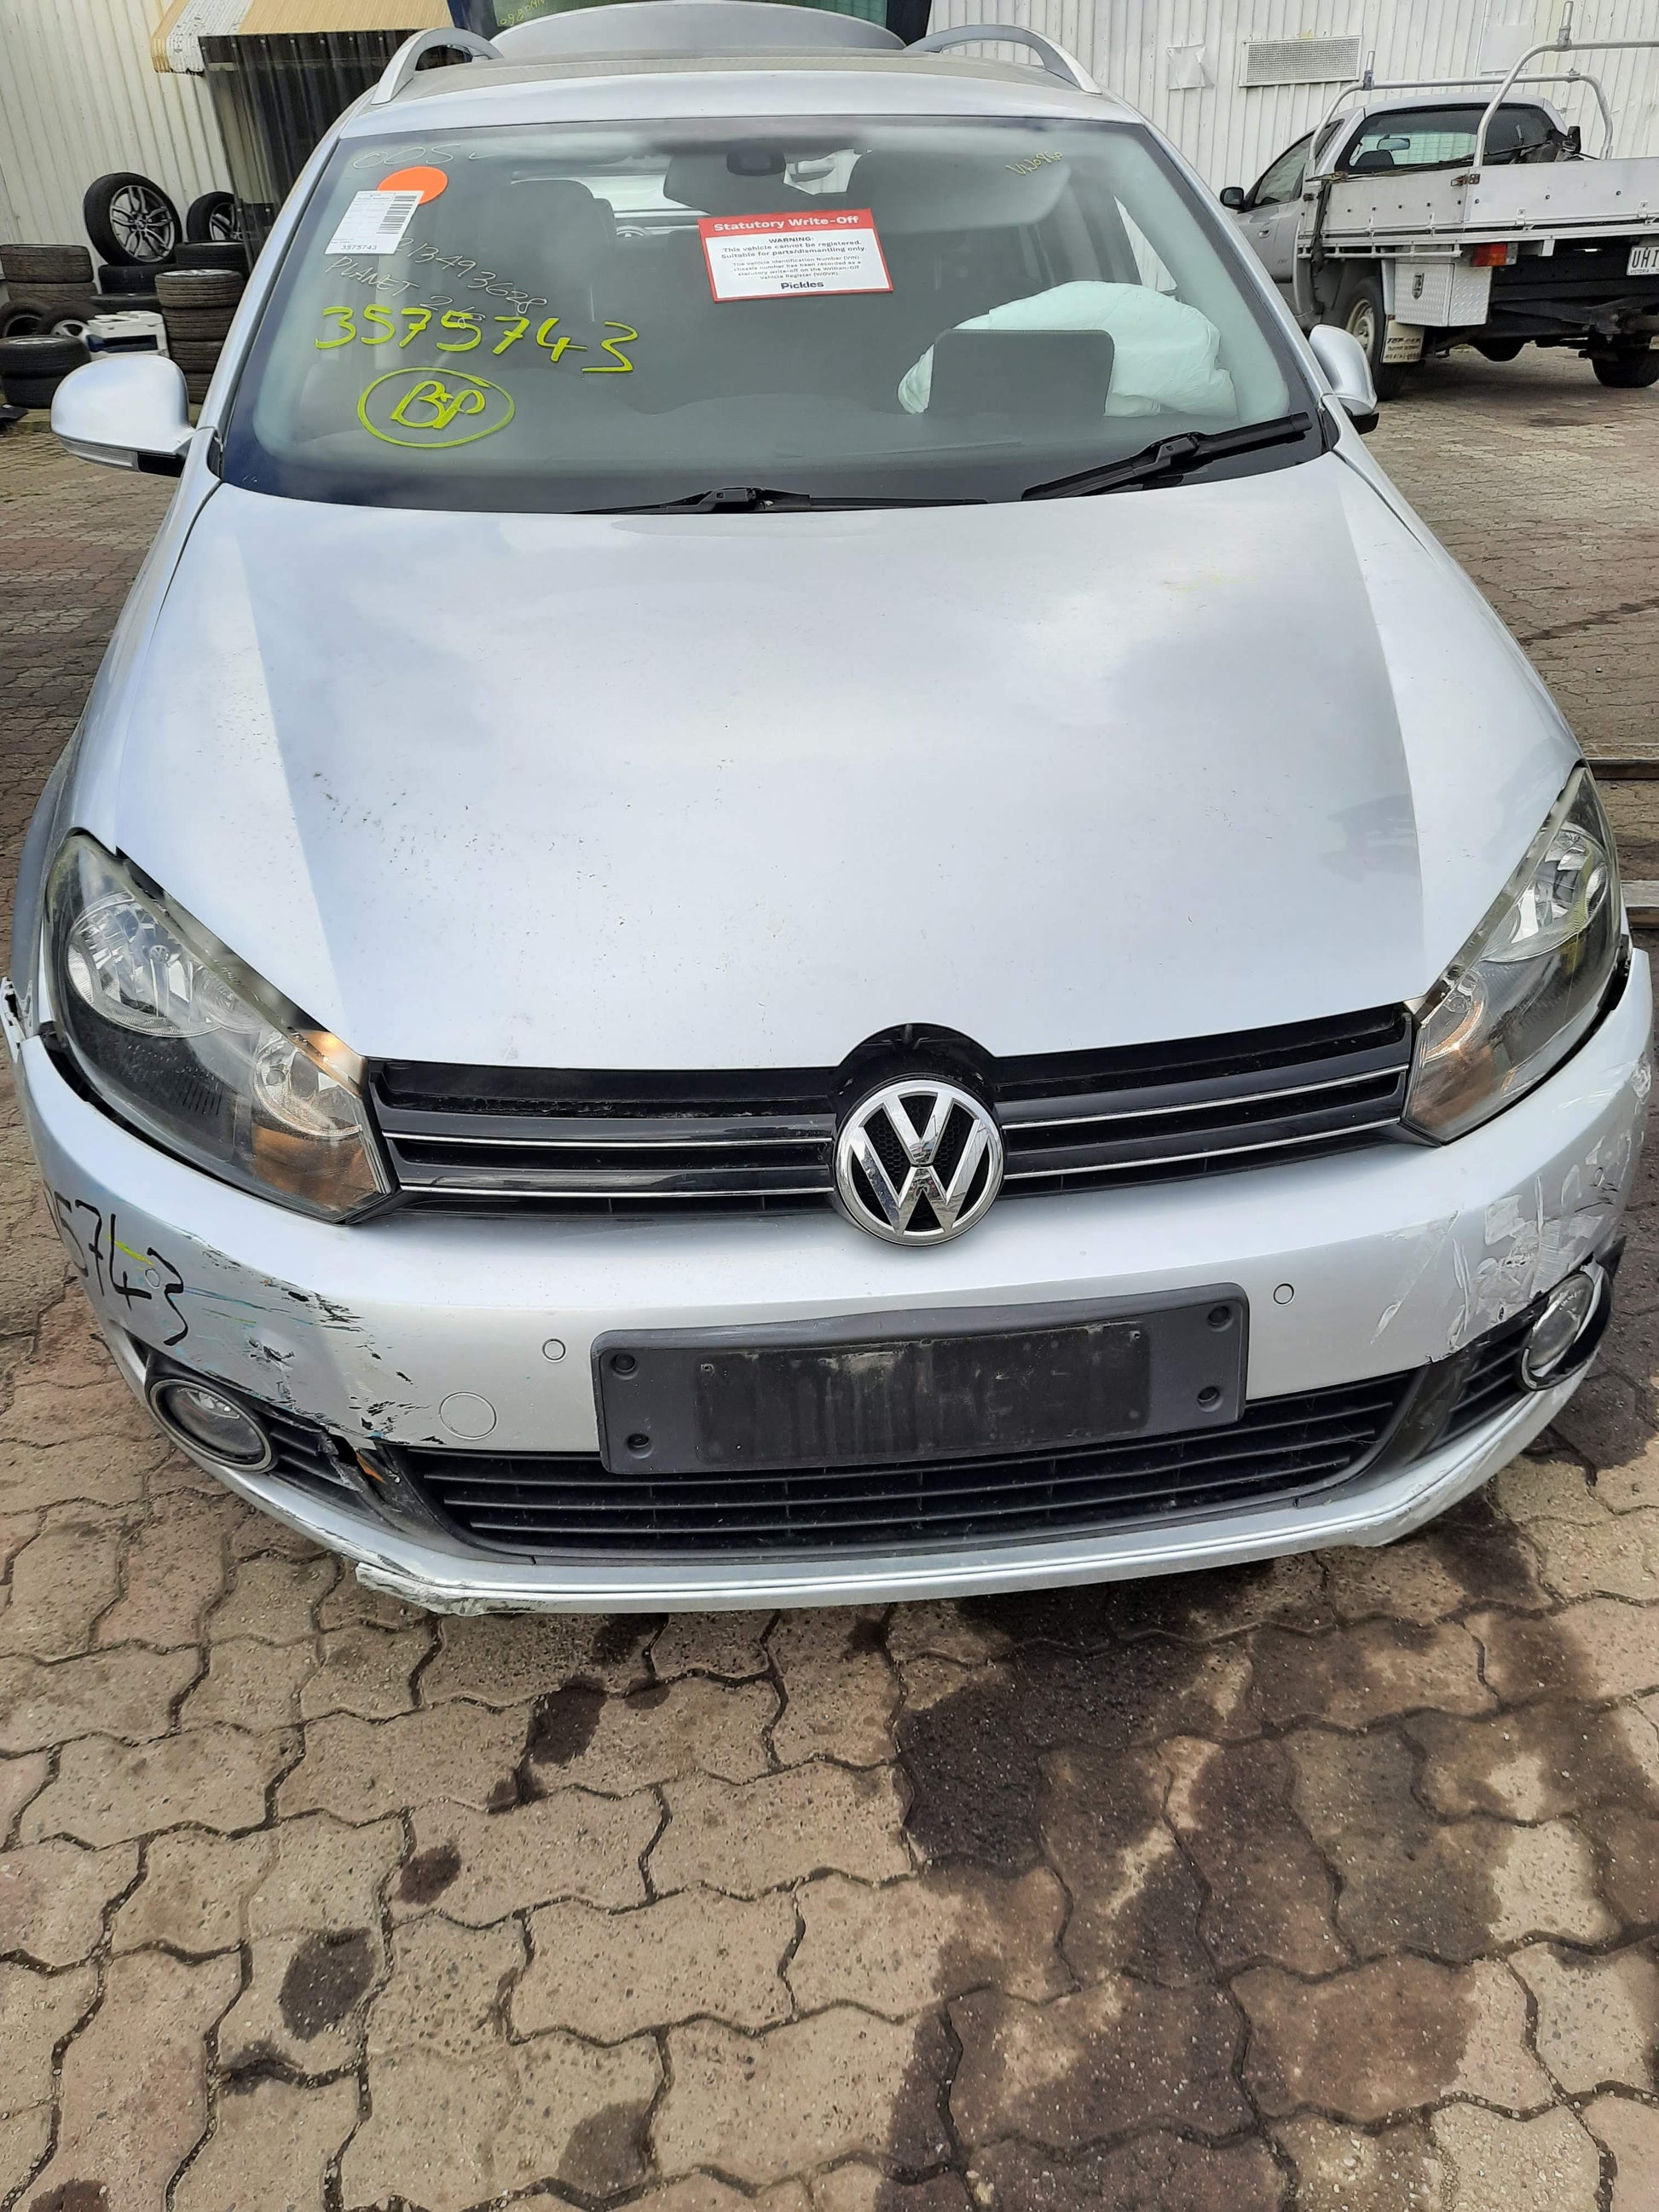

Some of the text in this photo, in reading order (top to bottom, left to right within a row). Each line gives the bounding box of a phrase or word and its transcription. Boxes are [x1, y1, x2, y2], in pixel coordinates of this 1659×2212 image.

[714, 216, 859, 231] Statutory Write-Off
[772, 246, 846, 257] parts/dismantling
[325, 256, 420, 296] PLANET
[781, 281, 824, 290] Pickles
[315, 303, 639, 373] 3575743
[839, 1080, 999, 1244] VW
